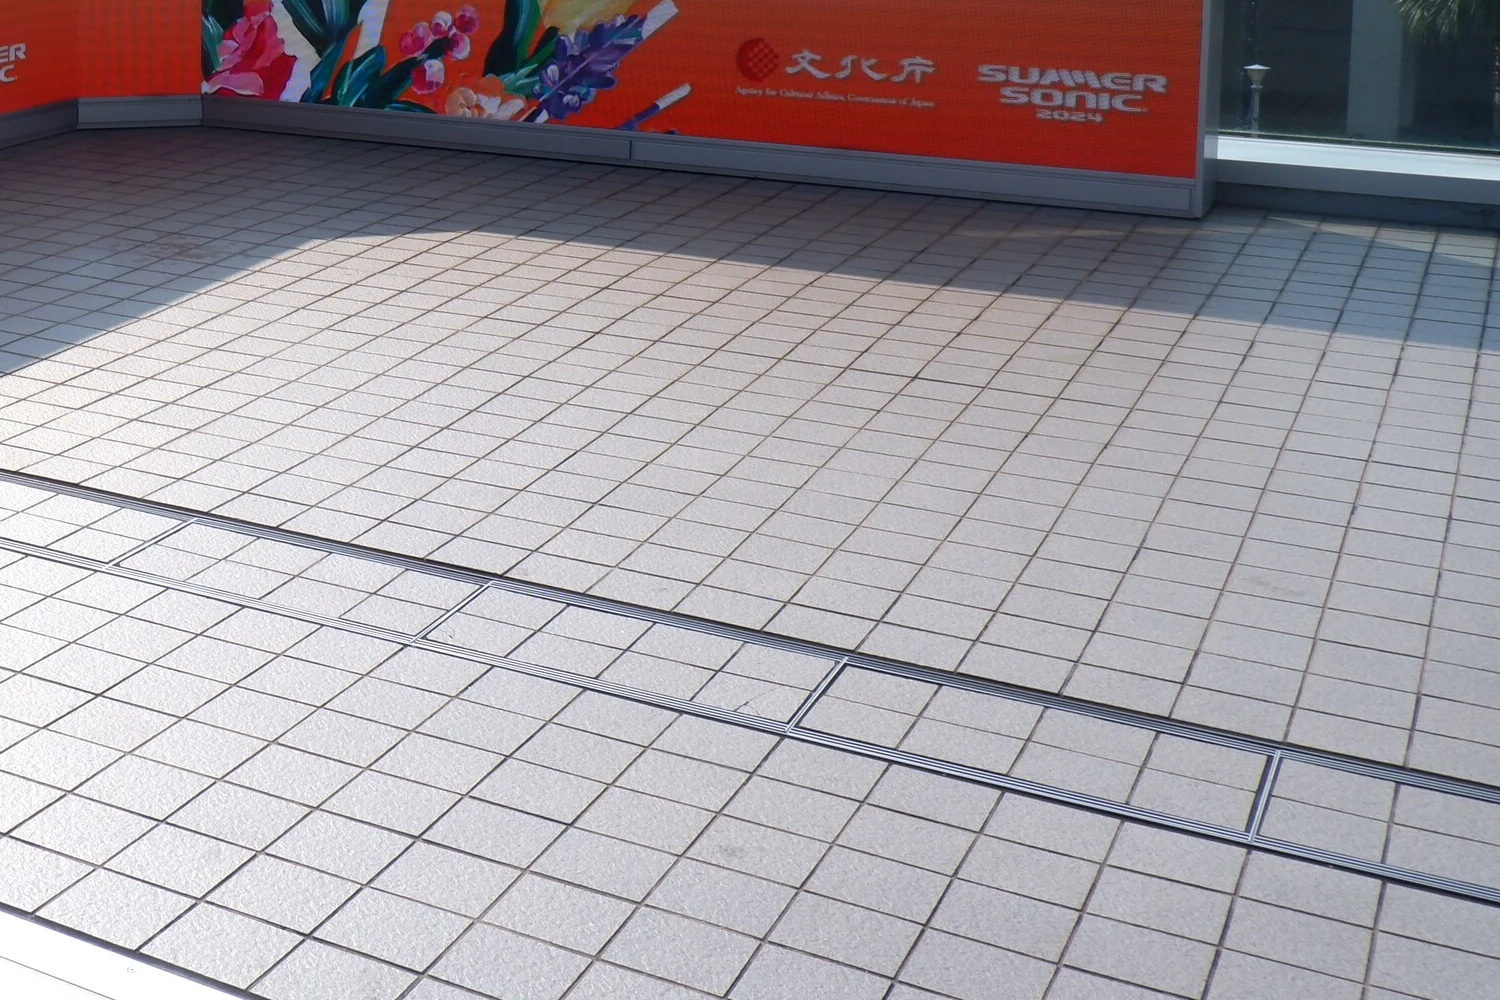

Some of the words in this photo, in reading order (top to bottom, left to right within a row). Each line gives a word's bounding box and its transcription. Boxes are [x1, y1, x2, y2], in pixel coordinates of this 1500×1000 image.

[784, 50, 936, 84] 文化庁
[978, 64, 1169, 94] SUMMER
[1000, 86, 1148, 113] SONIC
[1036, 109, 1105, 124] 2024
